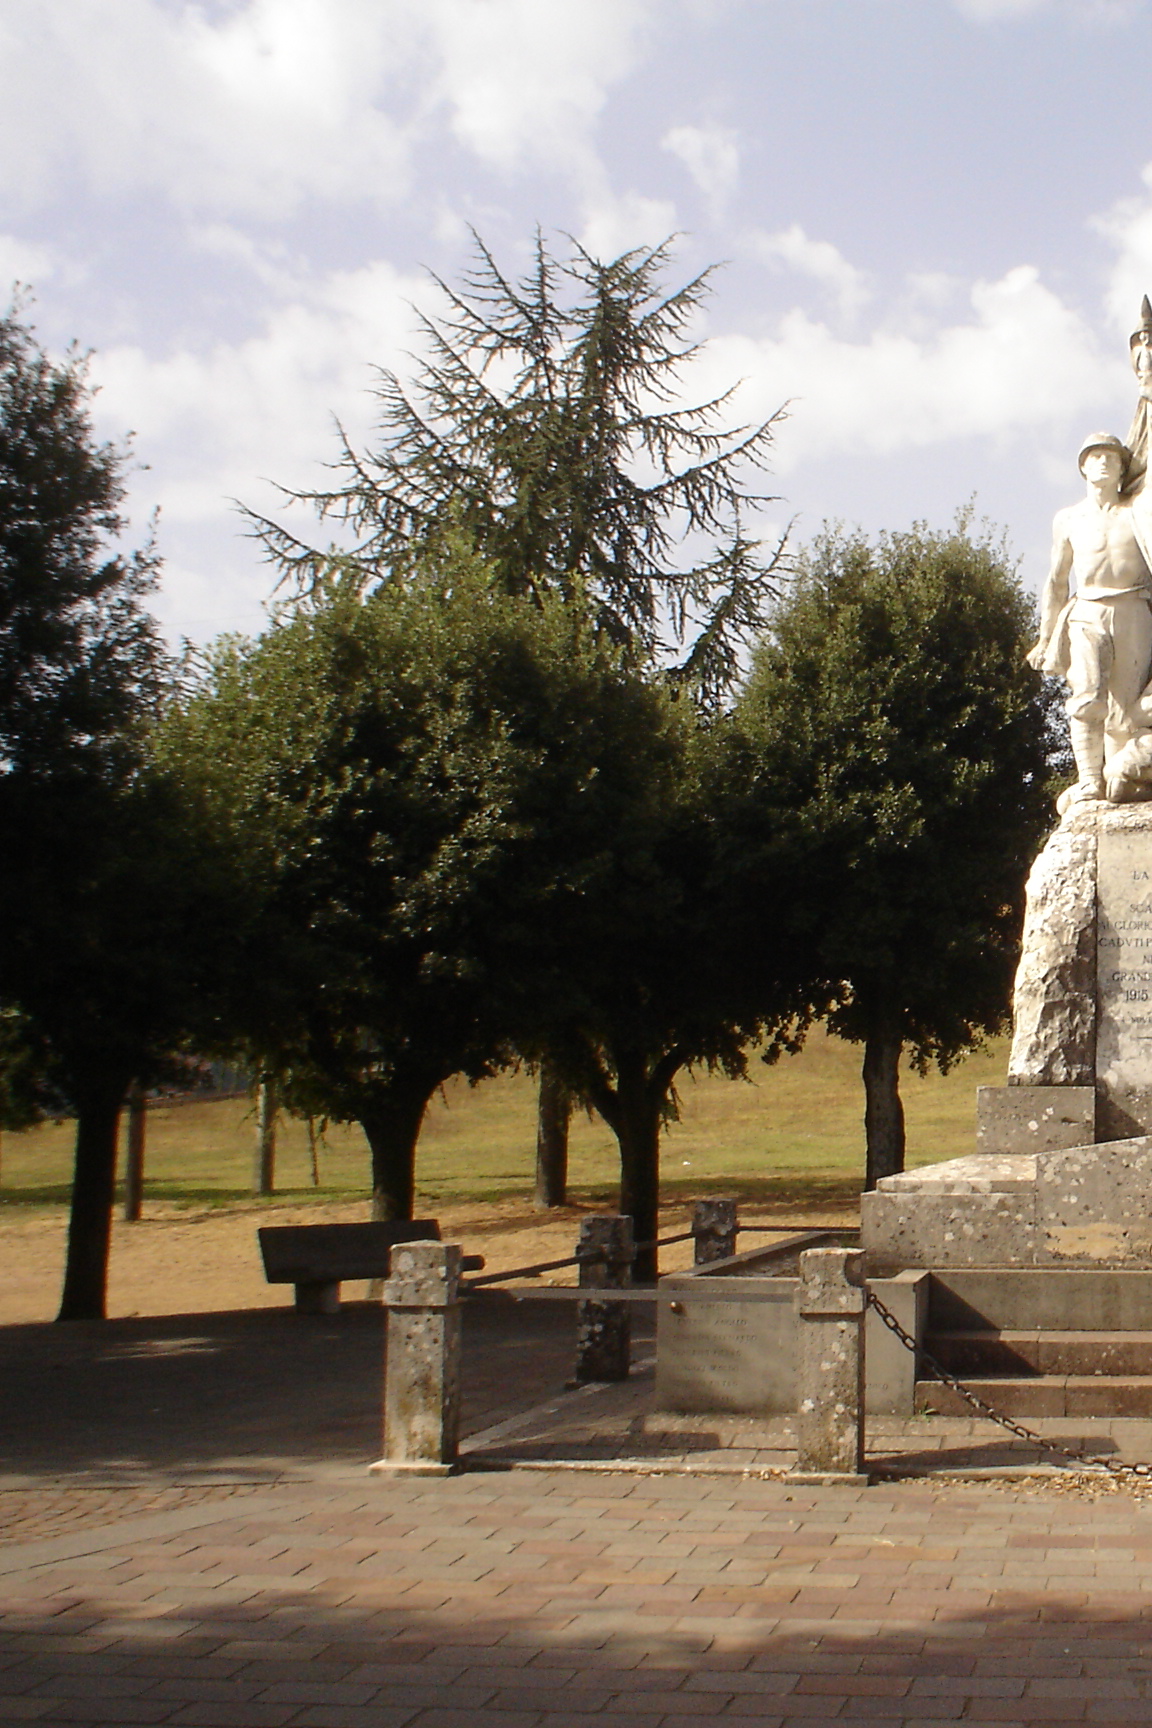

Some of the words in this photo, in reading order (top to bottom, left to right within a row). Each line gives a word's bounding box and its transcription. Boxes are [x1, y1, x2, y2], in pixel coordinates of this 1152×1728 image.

[1133, 870, 1150, 881] LA
[1098, 937, 1144, 948] CADVTI
[1125, 988, 1149, 1002] 1915
